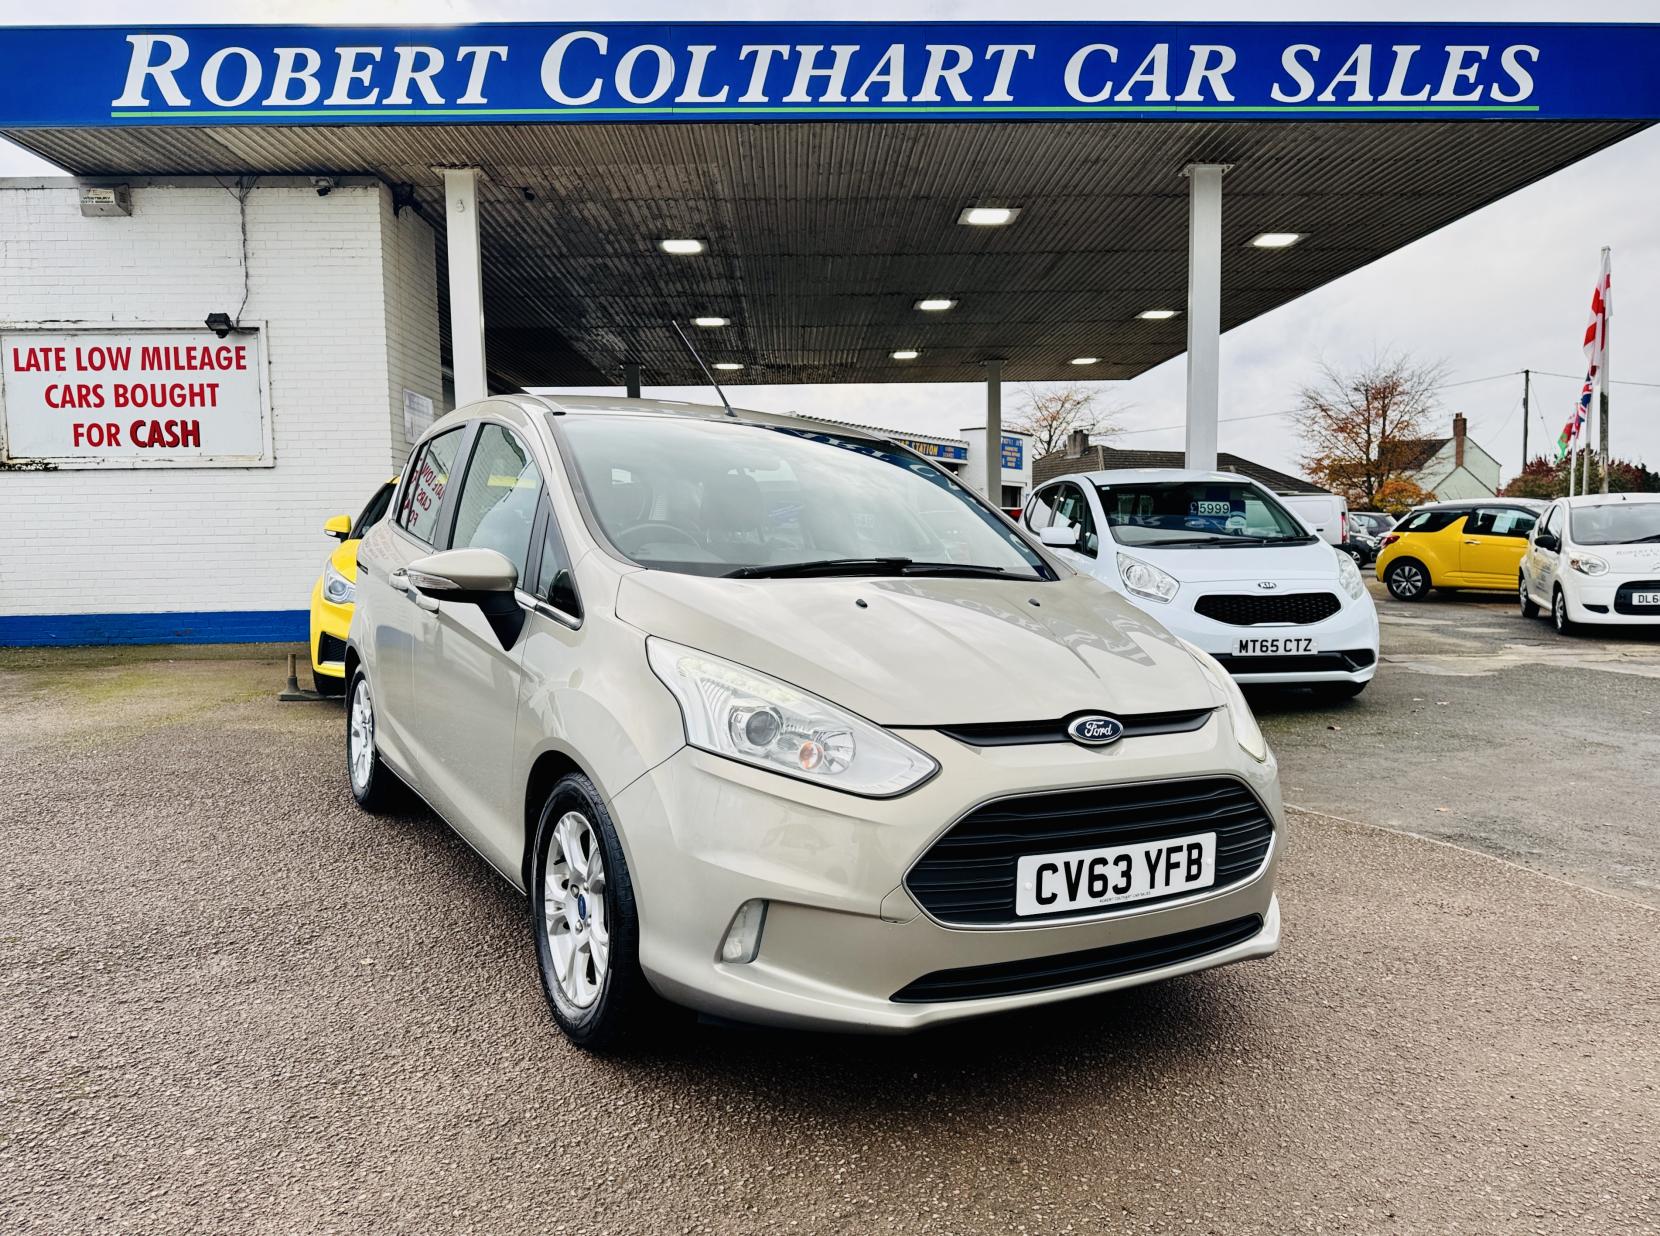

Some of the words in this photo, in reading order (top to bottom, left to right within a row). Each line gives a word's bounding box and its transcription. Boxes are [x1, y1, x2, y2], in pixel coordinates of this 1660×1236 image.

[111, 34, 509, 107] ROBERT
[540, 30, 1036, 106] COLTHART
[1064, 43, 1237, 103] CAR
[1270, 43, 1541, 103] SALES
[12, 346, 67, 372] LATE
[75, 346, 132, 372] LOW
[141, 345, 248, 371] MILEAGE
[44, 383, 106, 409] CARS
[114, 382, 220, 409] BOUGHT
[72, 422, 121, 448] FOR
[129, 419, 201, 449] CASH
[1238, 639, 1280, 654] MT65
[1283, 638, 1312, 653] CTZ
[1083, 720, 1113, 738] Ford
[1035, 853, 1133, 906] CV63
[1144, 842, 1203, 889] YFB
